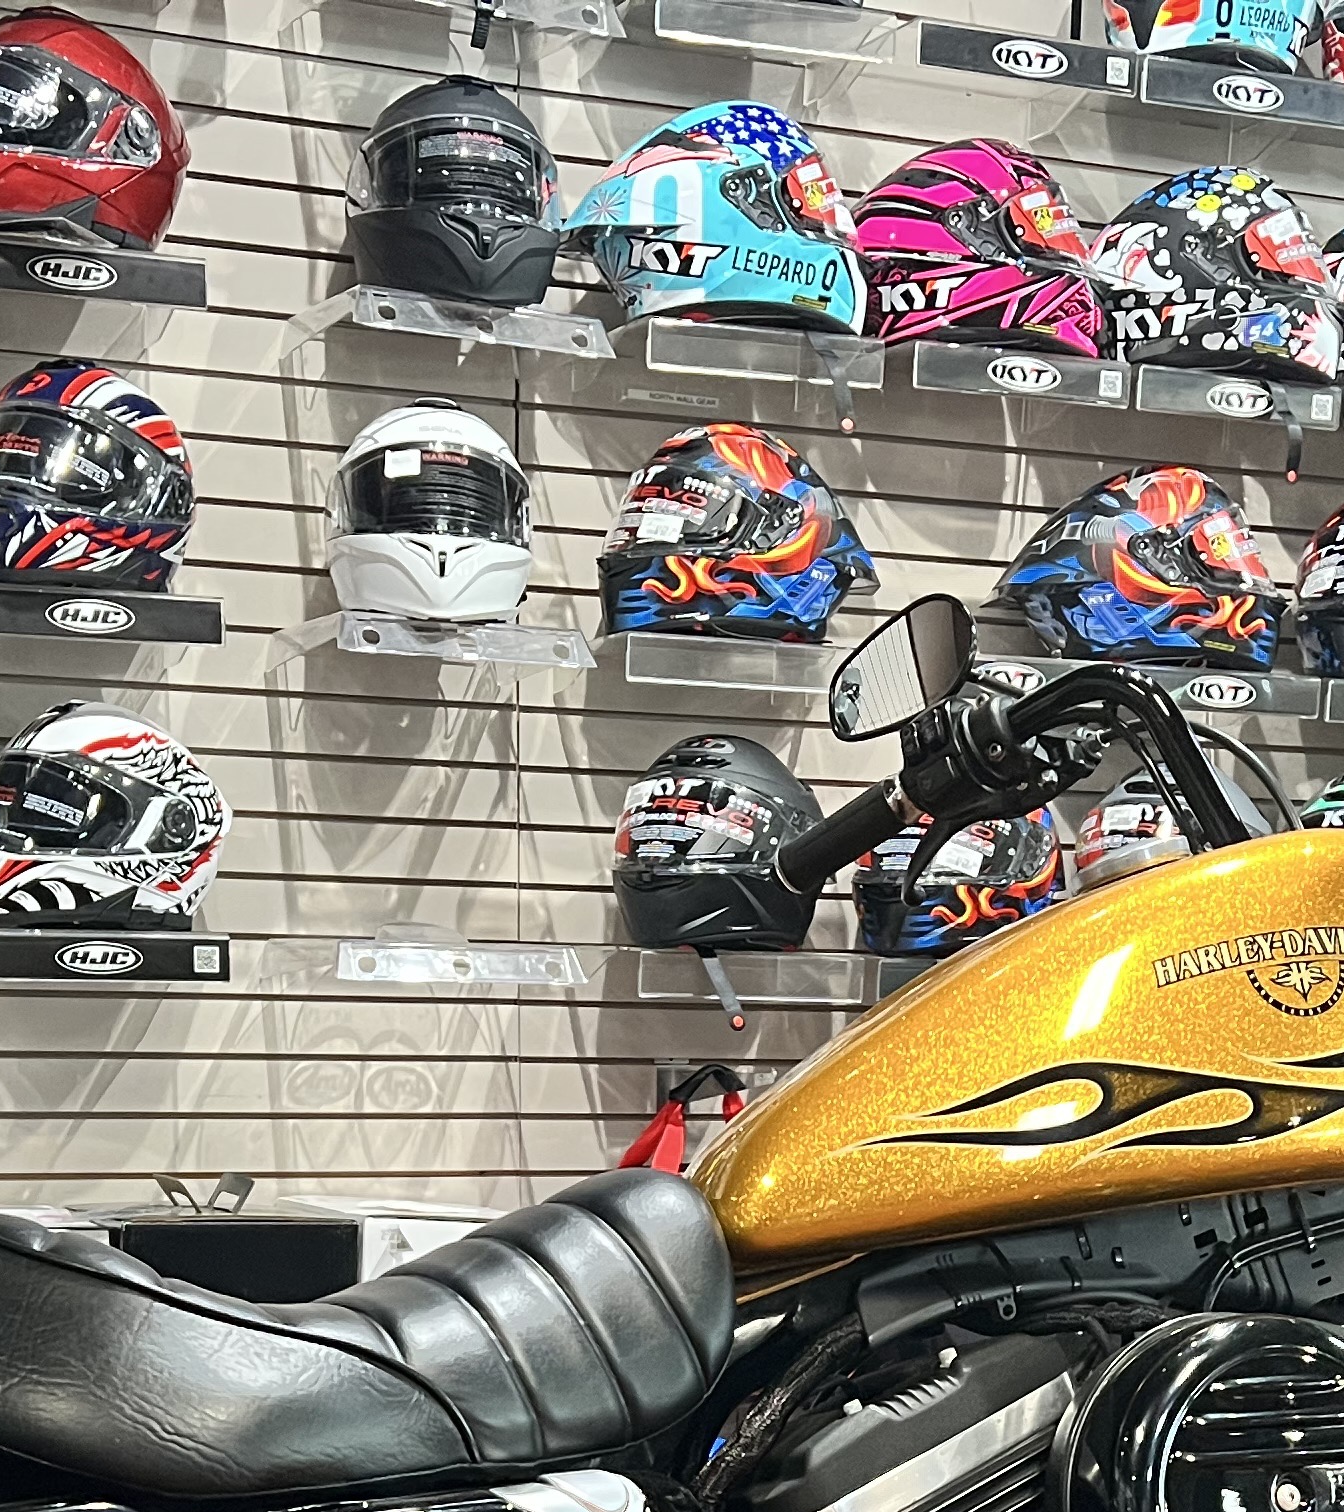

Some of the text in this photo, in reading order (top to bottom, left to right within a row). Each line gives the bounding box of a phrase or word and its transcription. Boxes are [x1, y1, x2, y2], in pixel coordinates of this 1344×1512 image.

[997, 49, 1060, 73] KYT
[1218, 79, 1281, 105] KYT
[39, 262, 104, 282] HJC
[626, 236, 728, 278] KYT
[732, 243, 817, 287] LEOPARD
[877, 277, 966, 312] KYT
[1112, 302, 1203, 340] KYT
[993, 361, 1057, 385] KYT
[59, 607, 124, 626] HJC
[1191, 680, 1251, 702] KYT
[68, 949, 132, 966] HJC
